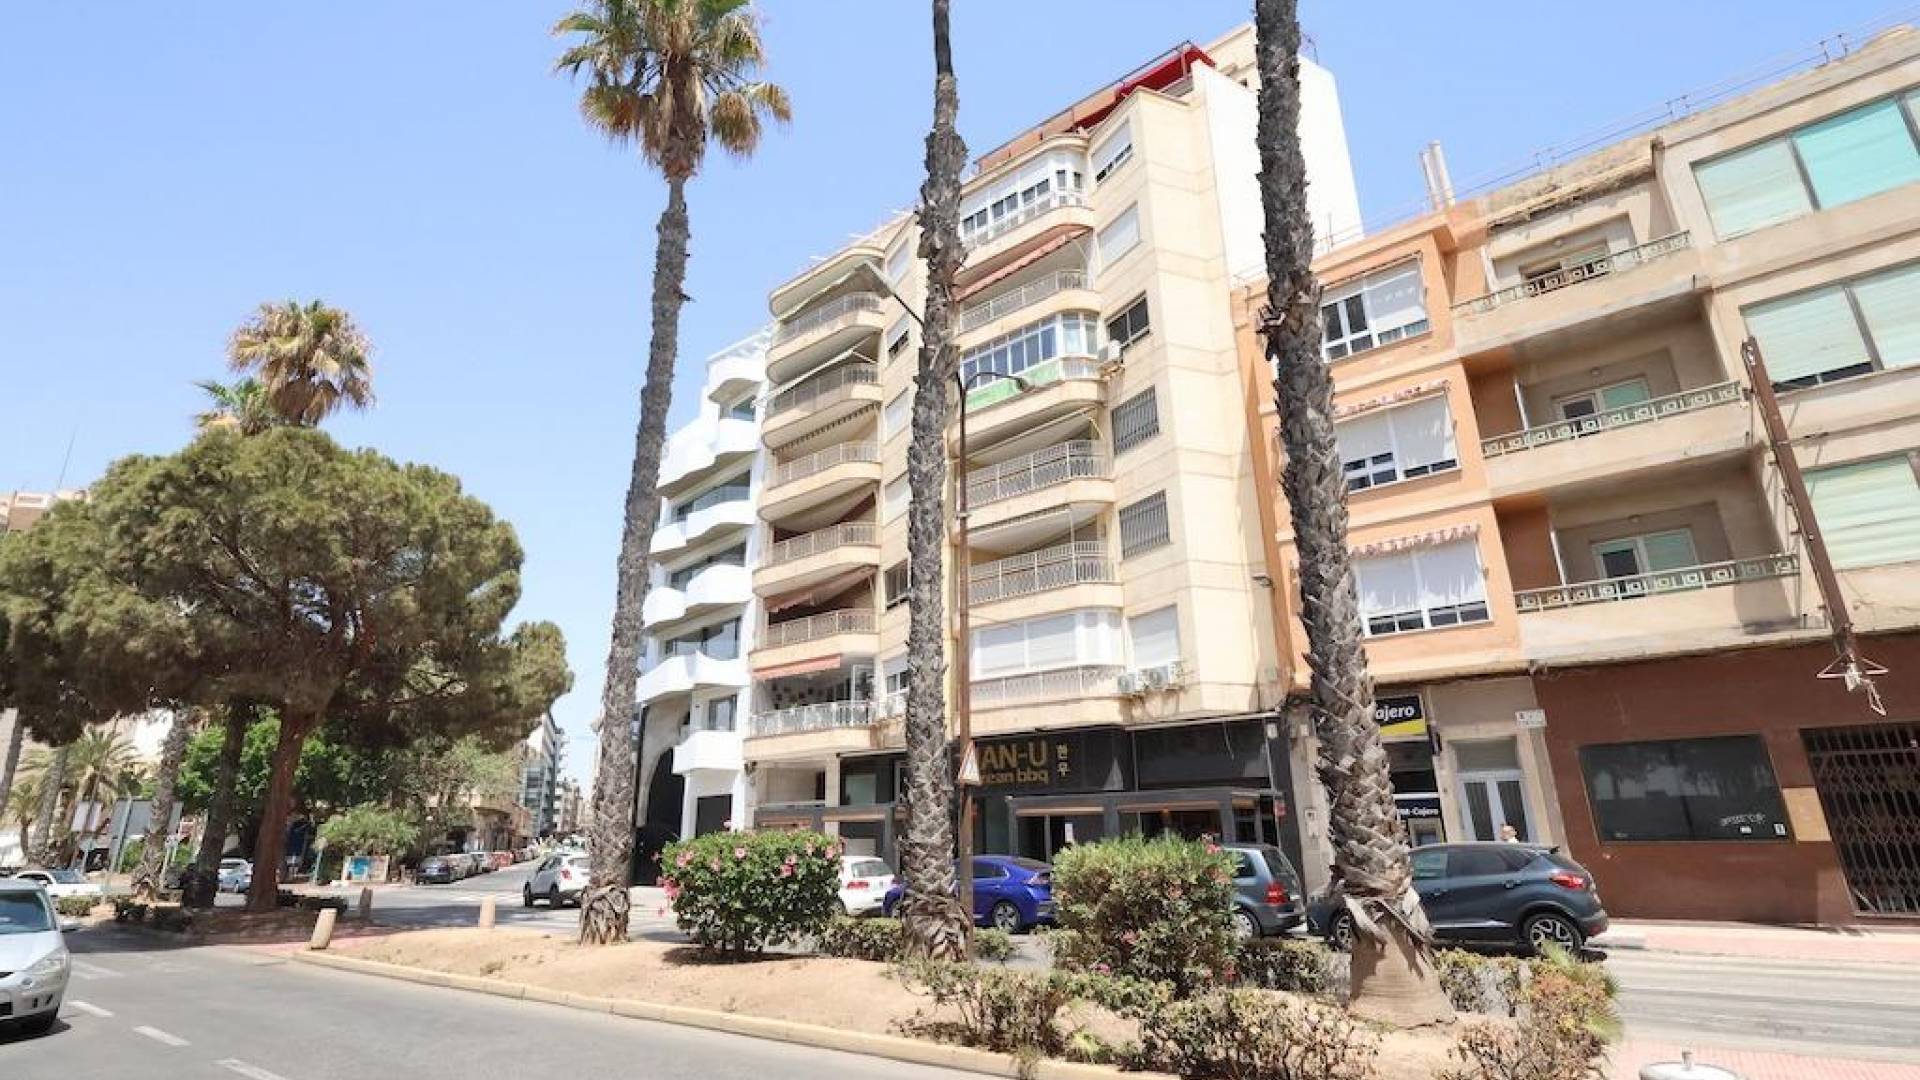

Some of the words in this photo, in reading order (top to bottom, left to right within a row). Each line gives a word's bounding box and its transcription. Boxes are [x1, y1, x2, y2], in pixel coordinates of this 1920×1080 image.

[1375, 705, 1415, 721] ajero
[980, 741, 1048, 769] AN-U
[1017, 767, 1048, 784] bbq
